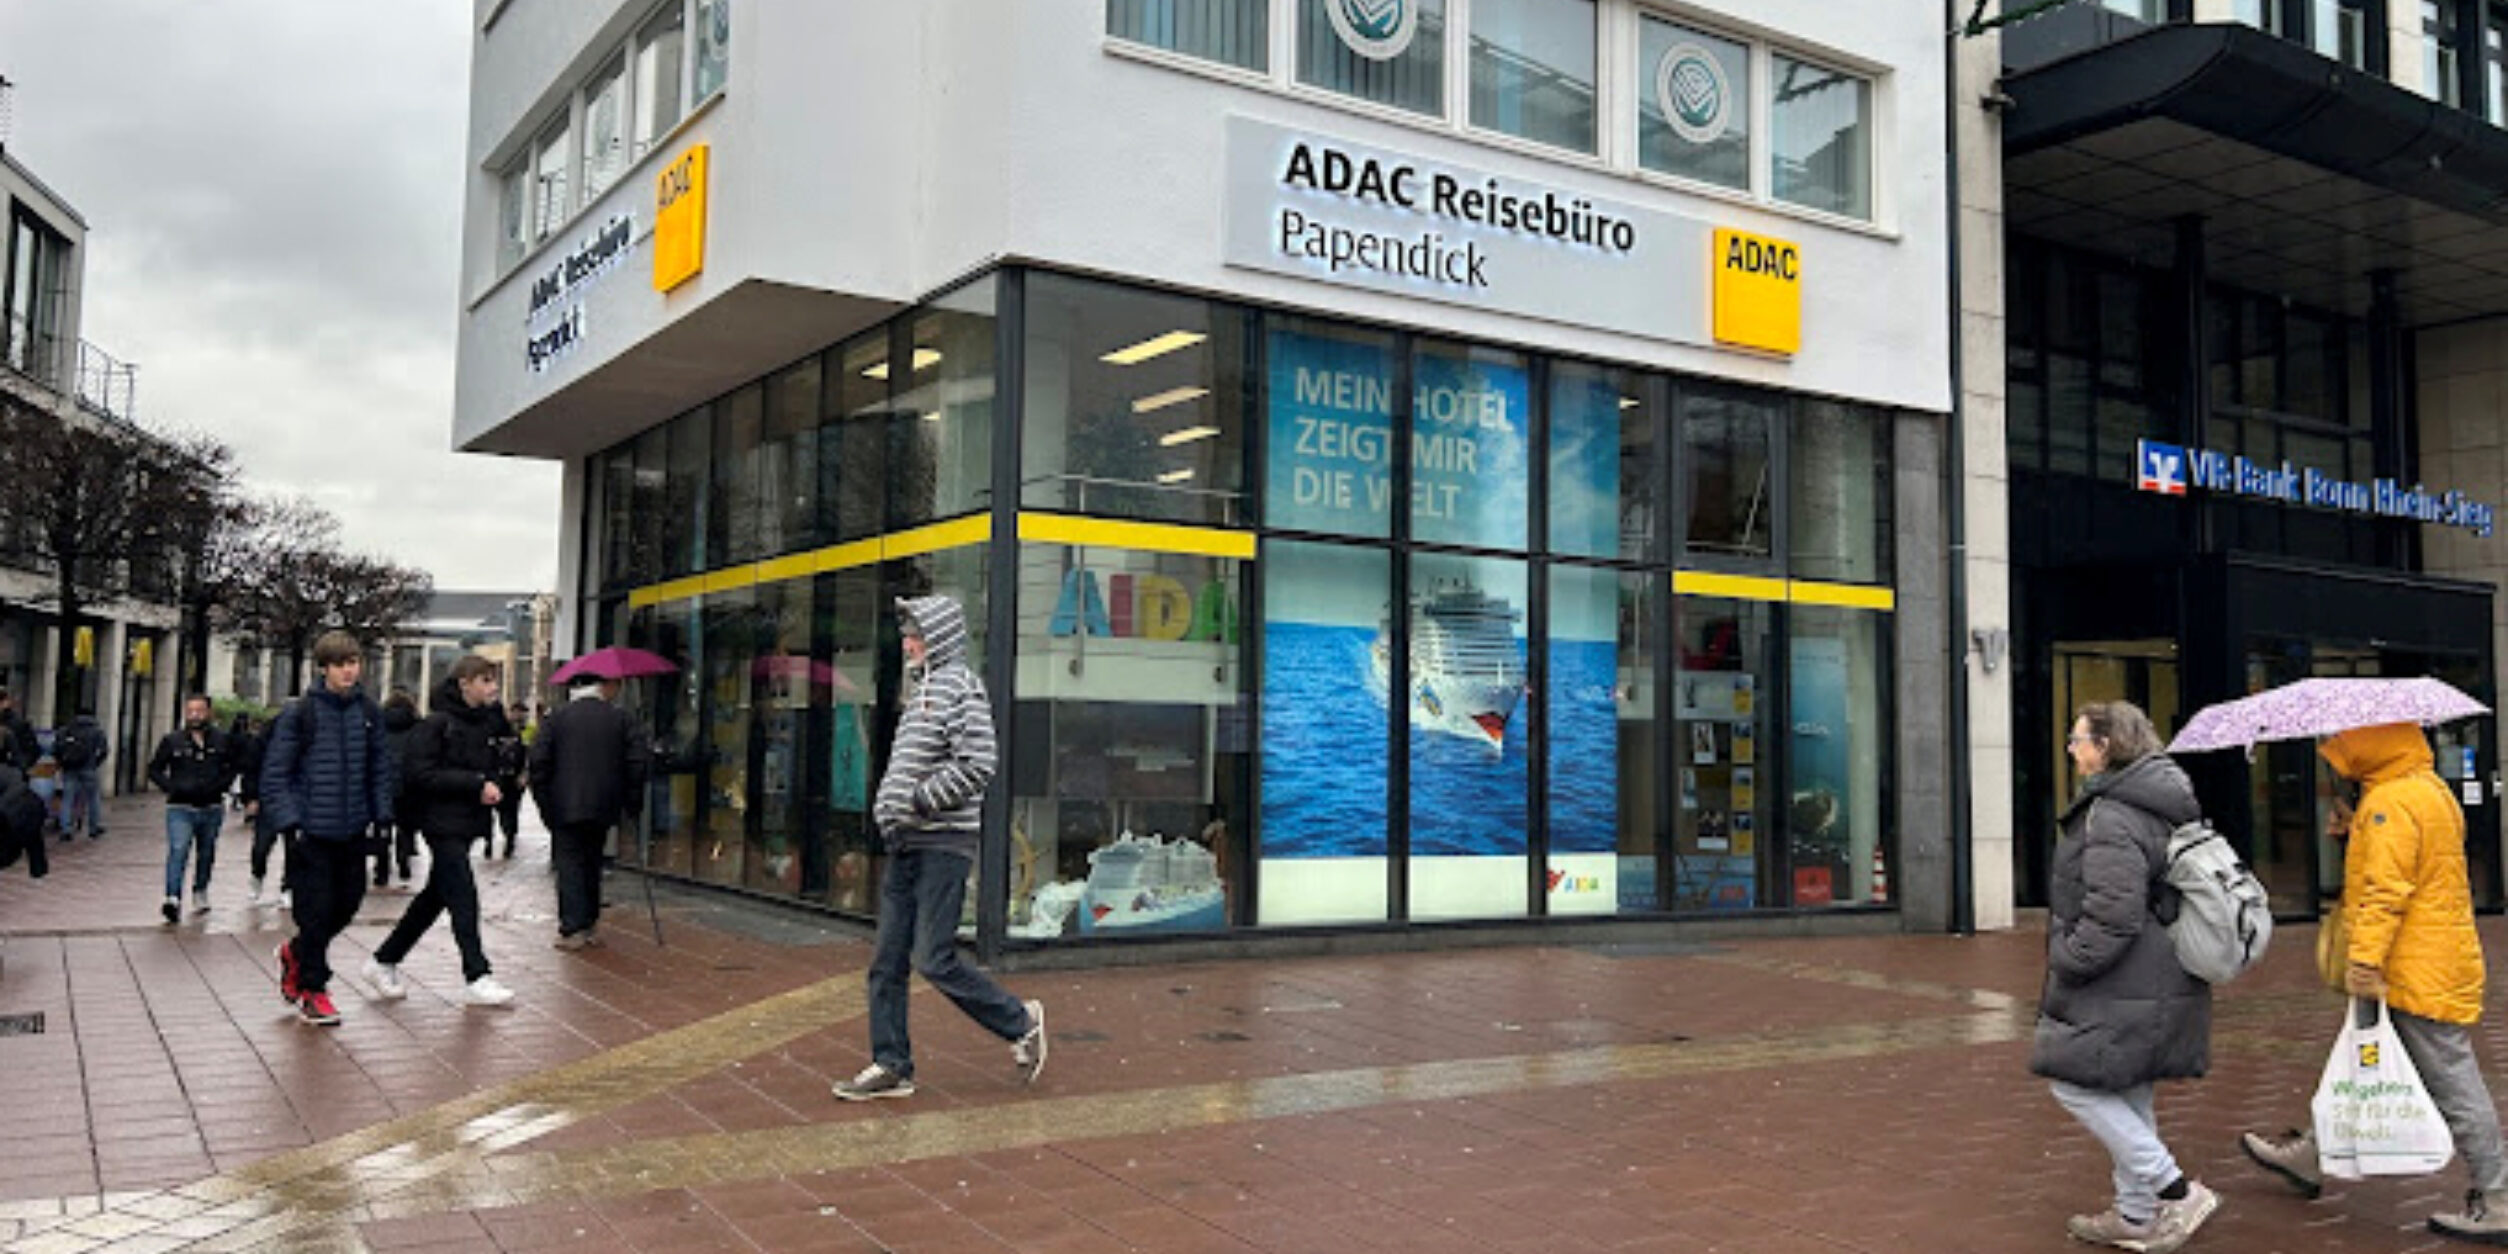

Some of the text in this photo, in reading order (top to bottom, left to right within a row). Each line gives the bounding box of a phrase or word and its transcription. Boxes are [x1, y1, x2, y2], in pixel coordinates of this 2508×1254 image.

[1282, 143, 1636, 252] ADAC Reisebüro
[1280, 209, 1489, 288] Papendick
[1725, 236, 1798, 282] ADAC
[1294, 366, 1514, 433] MEIN HOTEL
[1411, 432, 1478, 476] MIR
[1293, 466, 1354, 510] DIE
[1048, 567, 1239, 646] AIDA
